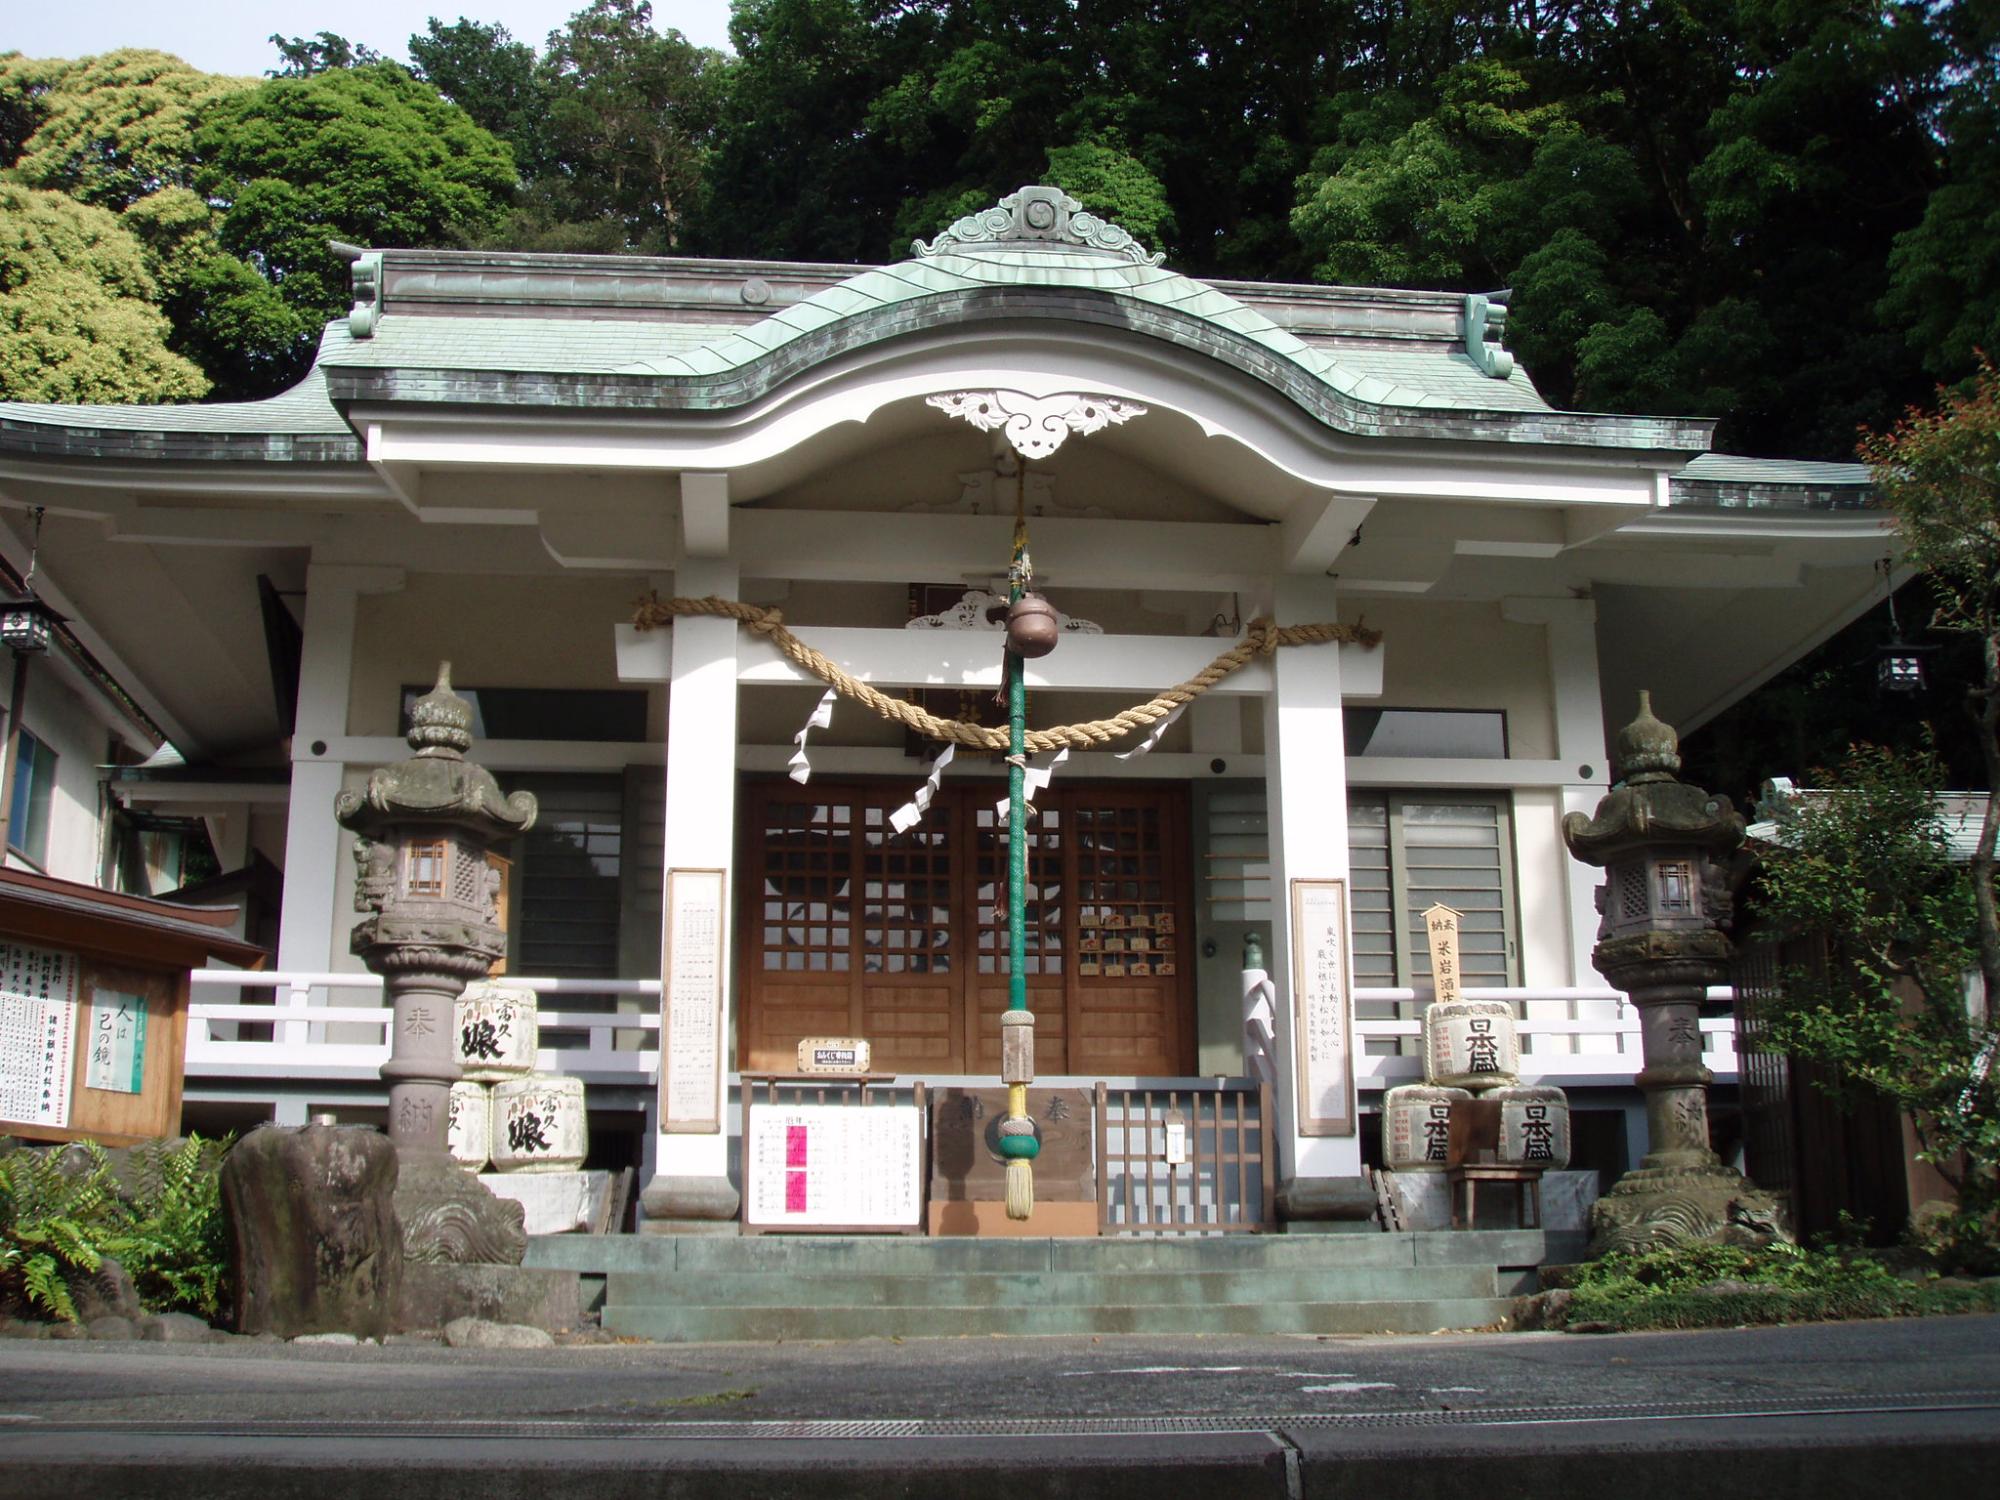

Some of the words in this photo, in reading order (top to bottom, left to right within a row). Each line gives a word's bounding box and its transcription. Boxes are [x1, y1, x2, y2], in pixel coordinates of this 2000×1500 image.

[1430, 917, 1456, 932] 奉納
[93, 1013, 112, 1066] 己の鏡
[116, 1003, 133, 1040] 人は
[1465, 1018, 1499, 1074] 日本盛
[400, 1007, 436, 1134] 奉納
[1520, 1104, 1552, 1162] 日本盛
